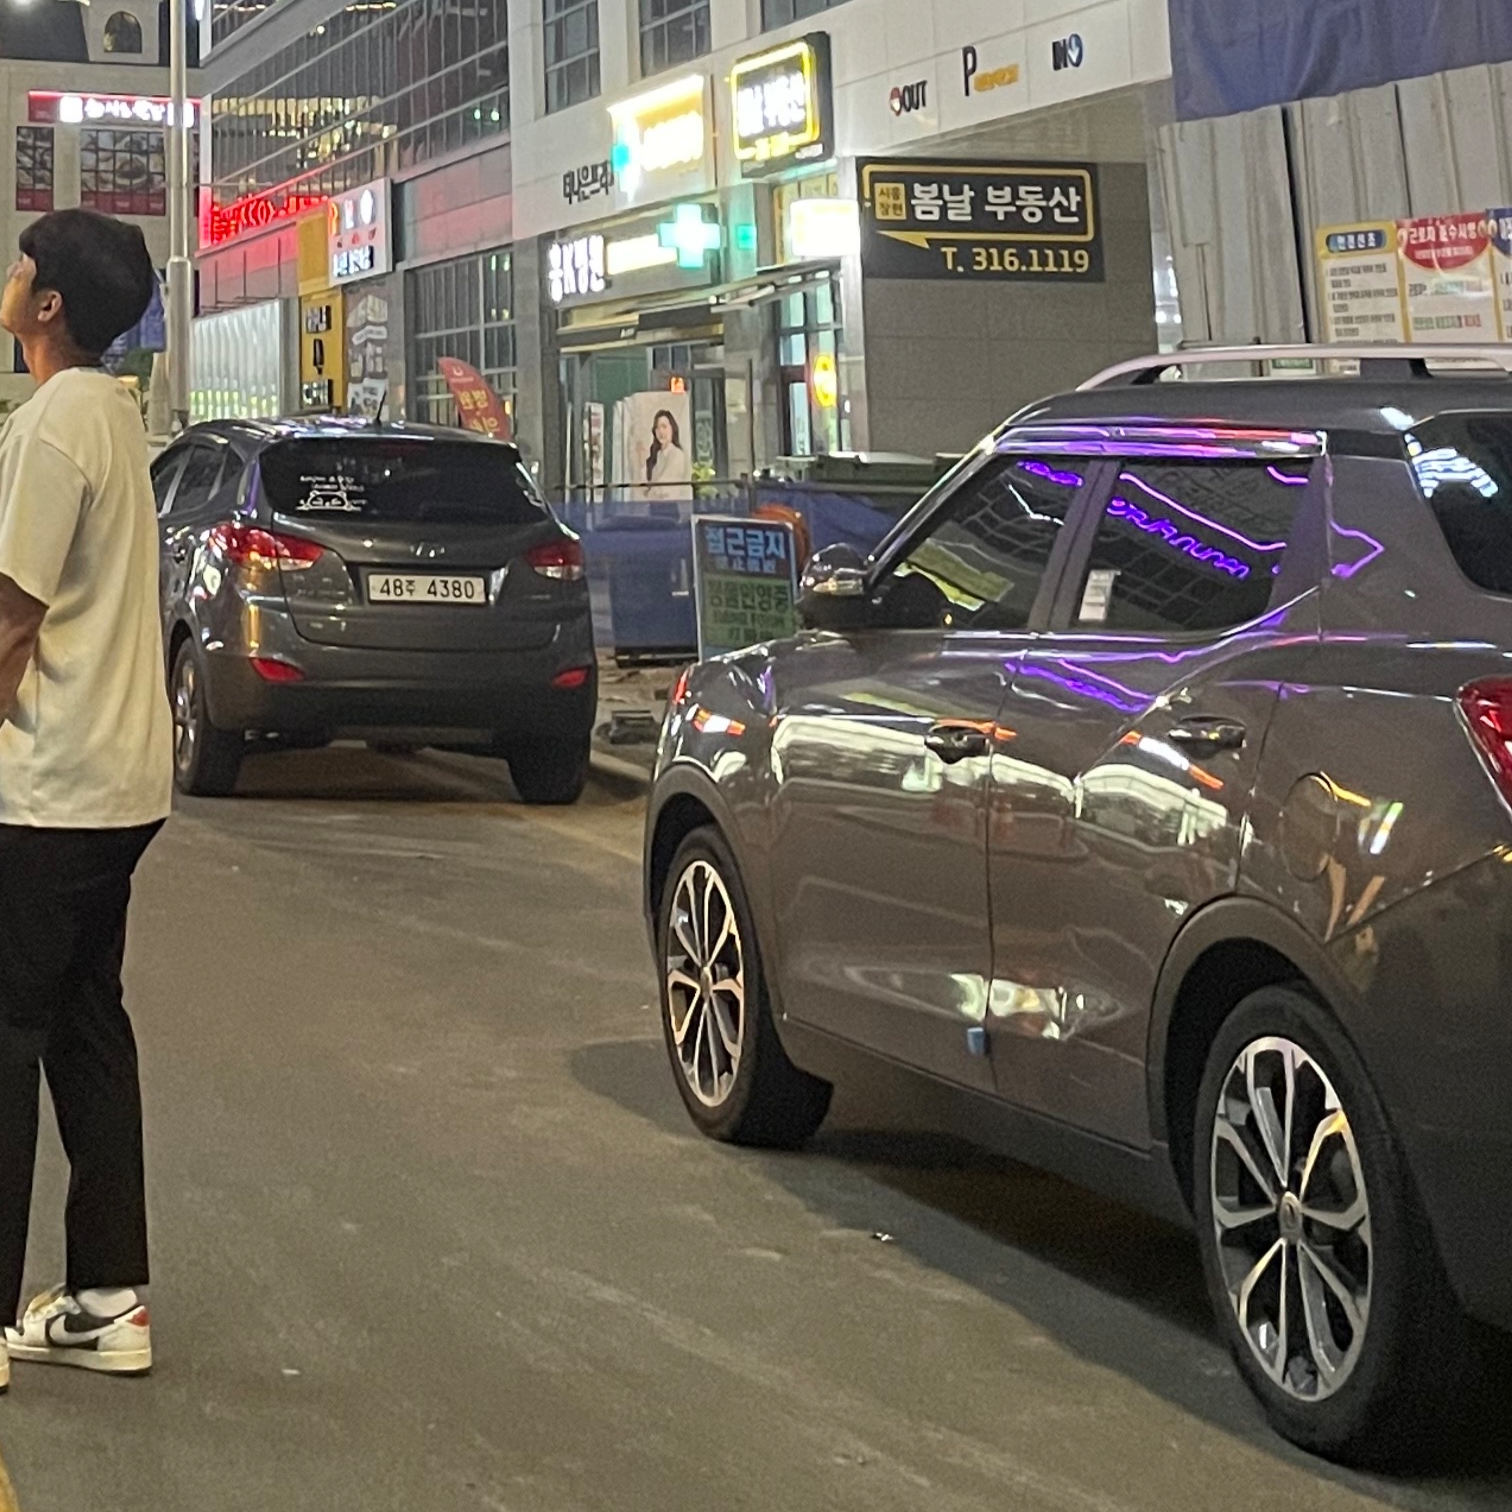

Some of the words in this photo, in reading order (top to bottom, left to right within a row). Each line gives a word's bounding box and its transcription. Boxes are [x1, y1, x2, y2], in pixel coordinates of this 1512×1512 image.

[903, 79, 928, 113] OUT
[911, 182, 975, 221] 봄날
[985, 185, 1081, 223] 부동산
[1409, 226, 1436, 244] 근로자
[1439, 222, 1477, 242] 준수사항
[941, 246, 964, 272] T.
[972, 247, 1090, 272] 316.1119
[705, 525, 786, 559] 접근금지
[426, 579, 475, 600] 4380
